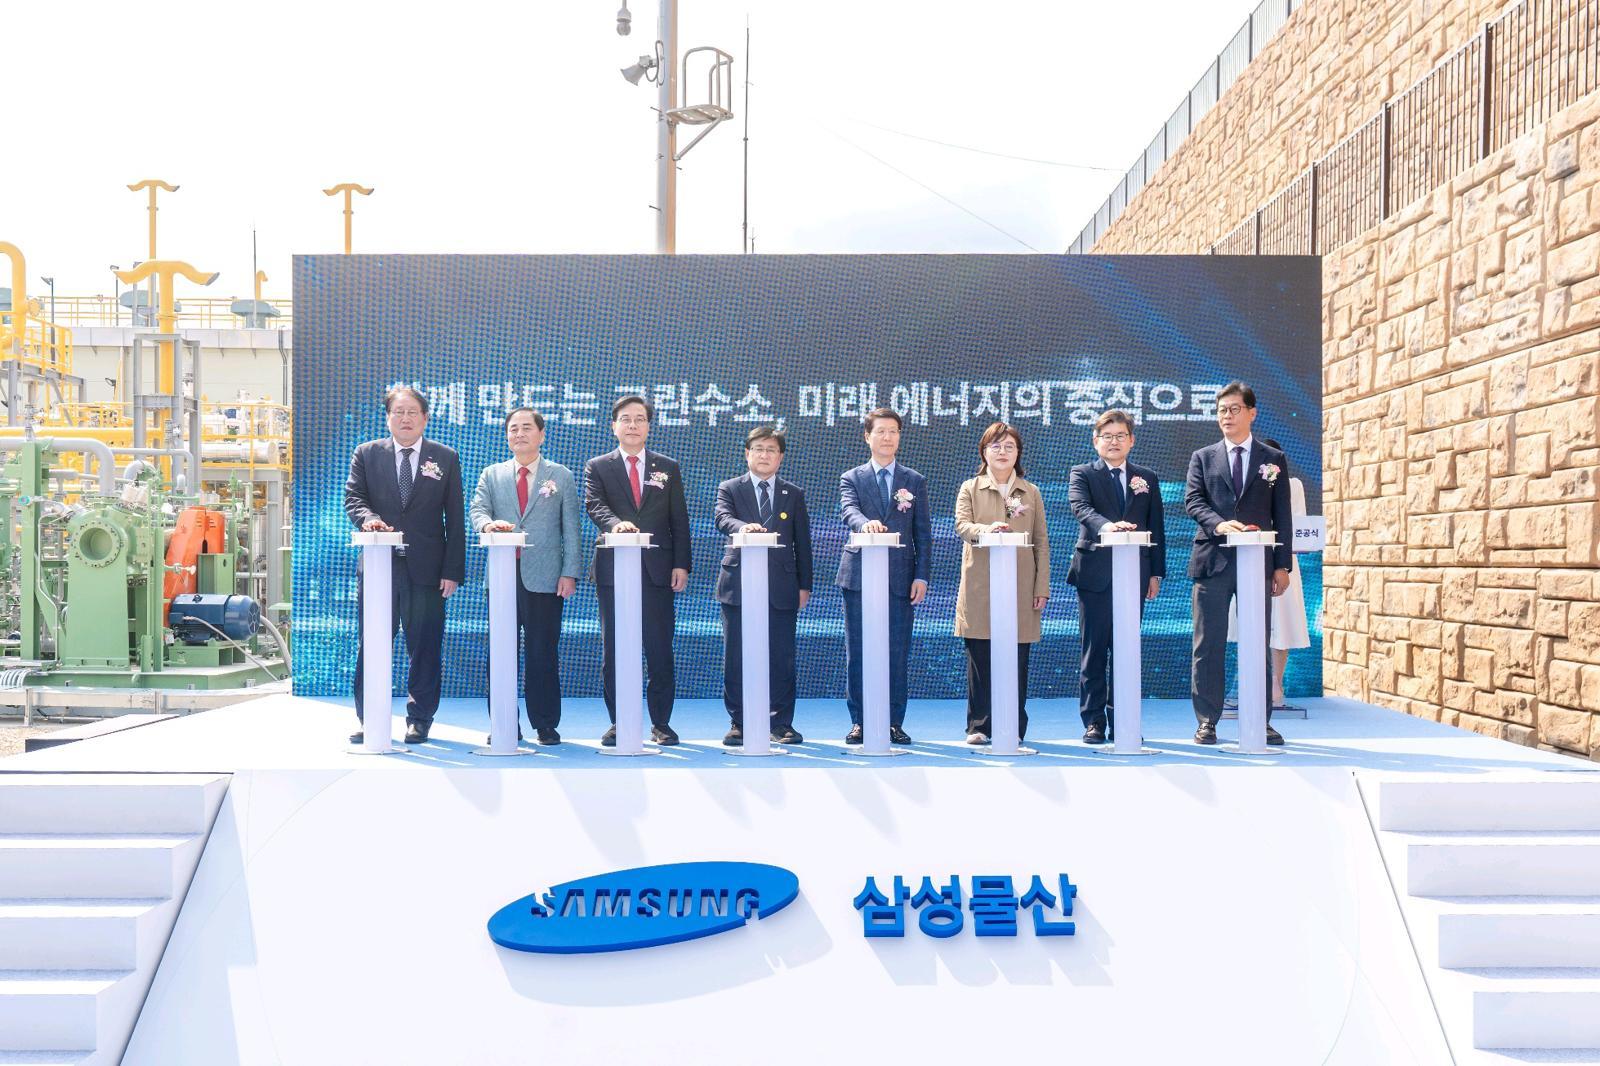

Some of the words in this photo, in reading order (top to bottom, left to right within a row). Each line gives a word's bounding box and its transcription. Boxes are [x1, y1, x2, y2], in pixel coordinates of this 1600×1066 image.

[478, 382, 600, 425] 만드는
[799, 382, 877, 426] 미래
[890, 382, 1051, 426] 에너지의
[1064, 381, 1223, 426] 중심으로
[1295, 528, 1319, 538] 준공식
[530, 887, 761, 923] SAMSUNG
[853, 873, 1077, 938] 삼성물산
